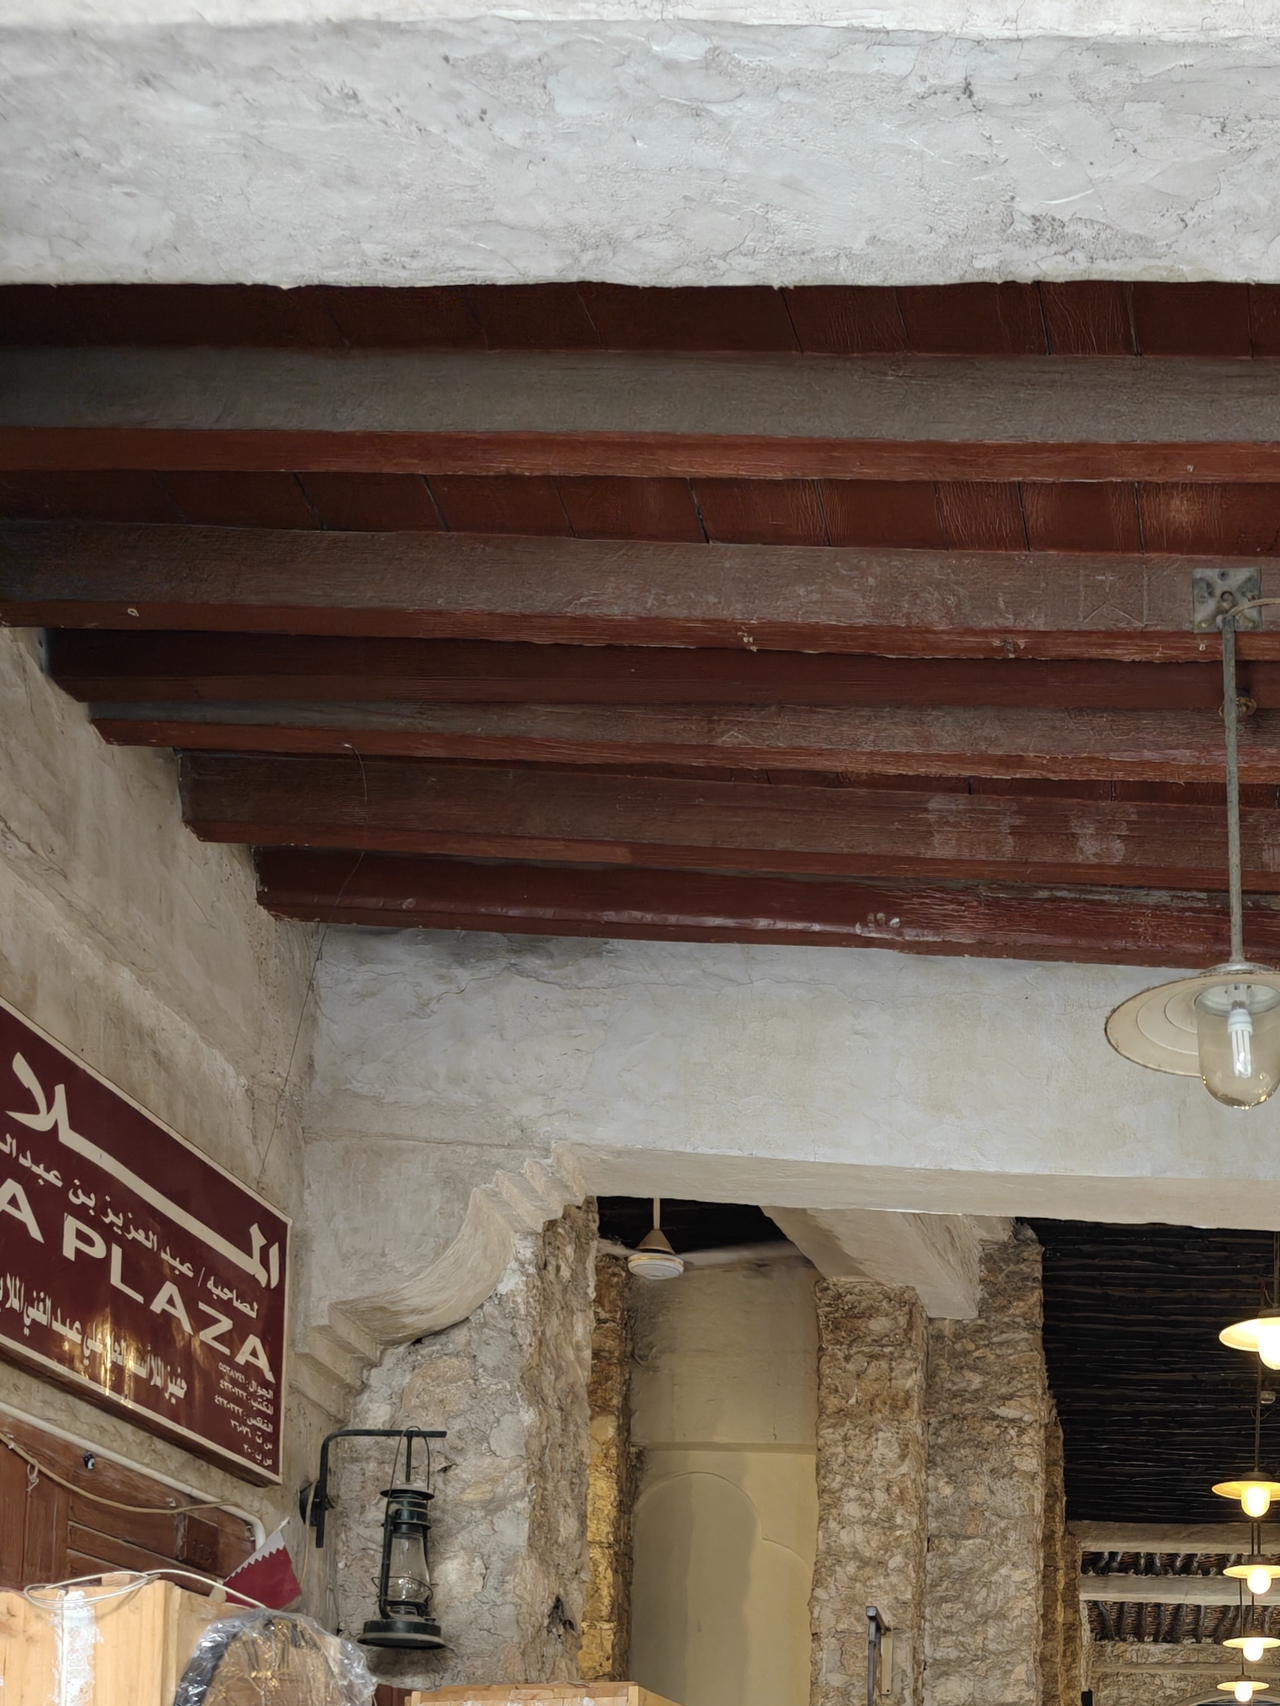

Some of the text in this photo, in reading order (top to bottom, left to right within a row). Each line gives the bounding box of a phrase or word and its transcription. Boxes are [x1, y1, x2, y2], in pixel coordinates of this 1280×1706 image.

[69, 1179, 95, 1215] بن
[101, 1196, 158, 1252] العزيز
[161, 1242, 194, 1280] عبد
[63, 1213, 276, 1383] PLAZA
